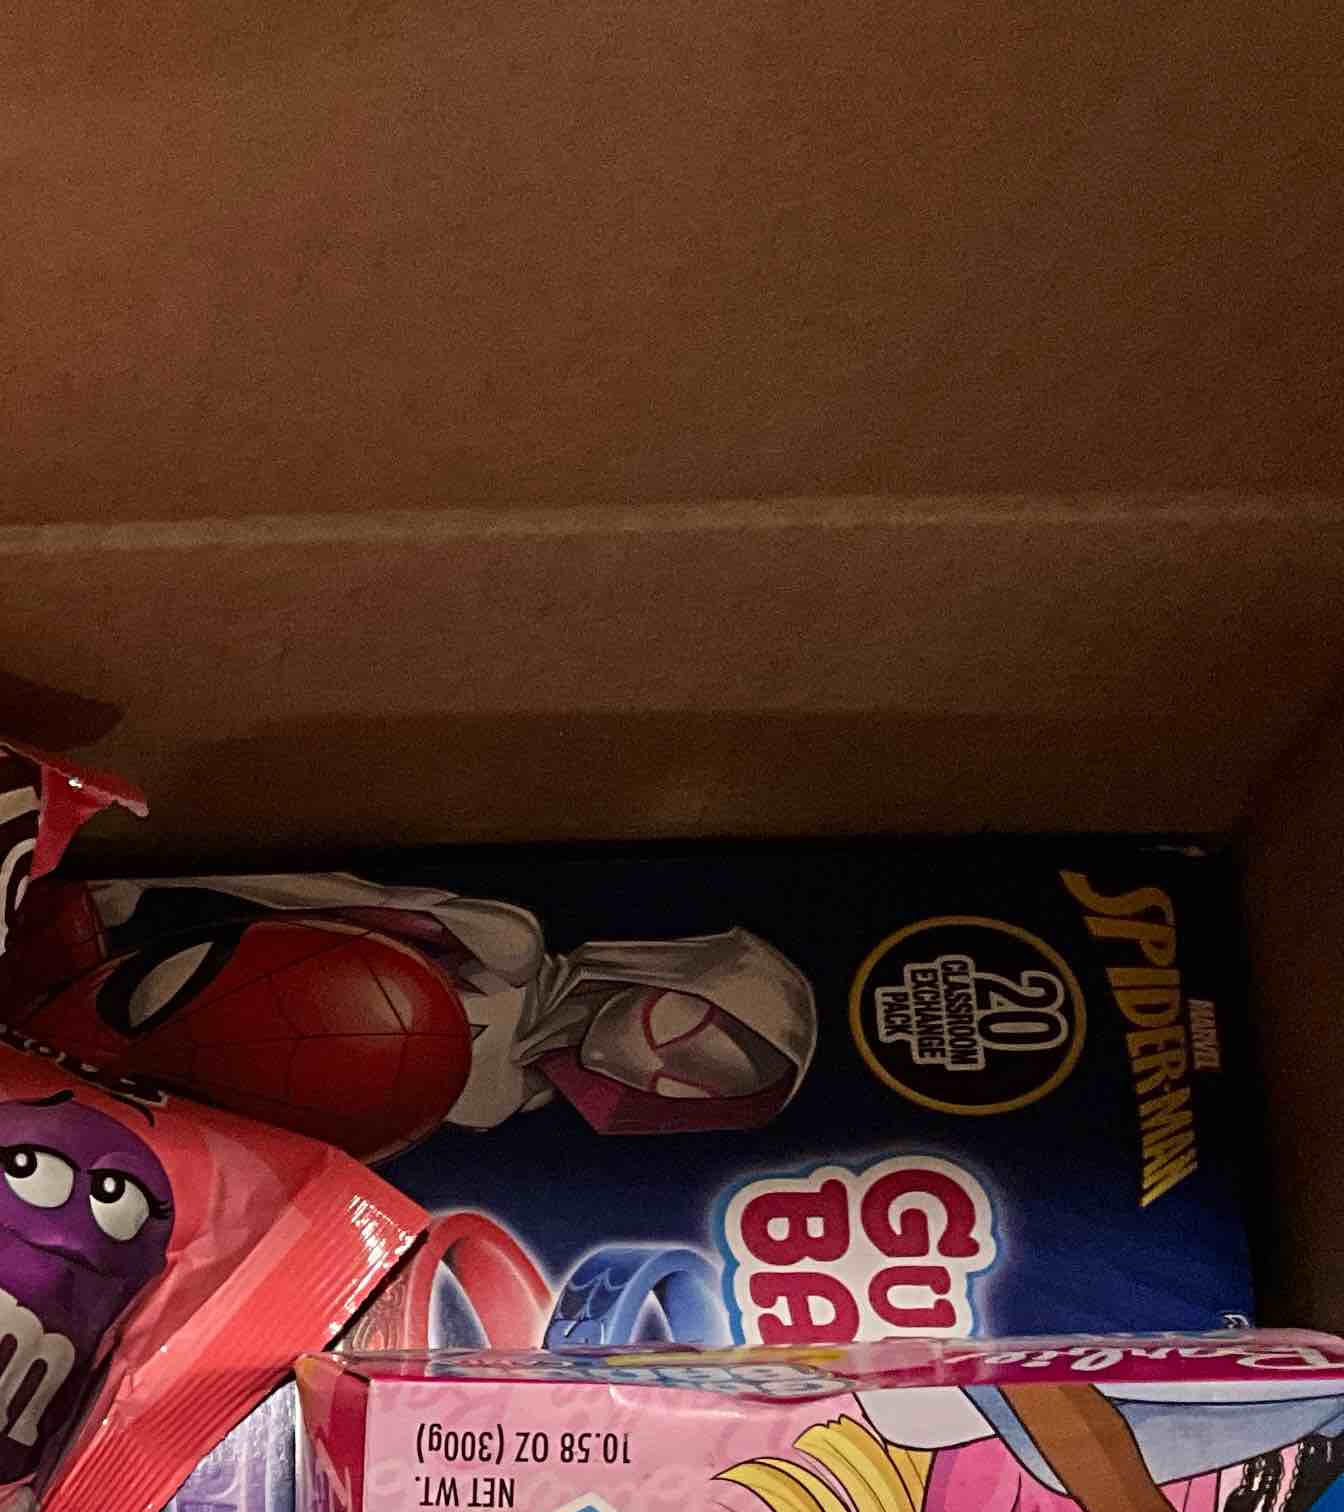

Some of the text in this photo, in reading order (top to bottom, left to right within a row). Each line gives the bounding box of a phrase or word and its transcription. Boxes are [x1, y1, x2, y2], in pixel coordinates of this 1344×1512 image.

[882, 990, 911, 1038] PACK
[911, 967, 946, 1062] EXCHANGE
[941, 957, 978, 1067] CLASSROOM
[976, 972, 1067, 1048] 20
[1059, 870, 1198, 1209] SPIDER-MAN
[415, 1423, 633, 1464] 10.58 OZ (300g)
[414, 1472, 516, 1509] NET WT.
